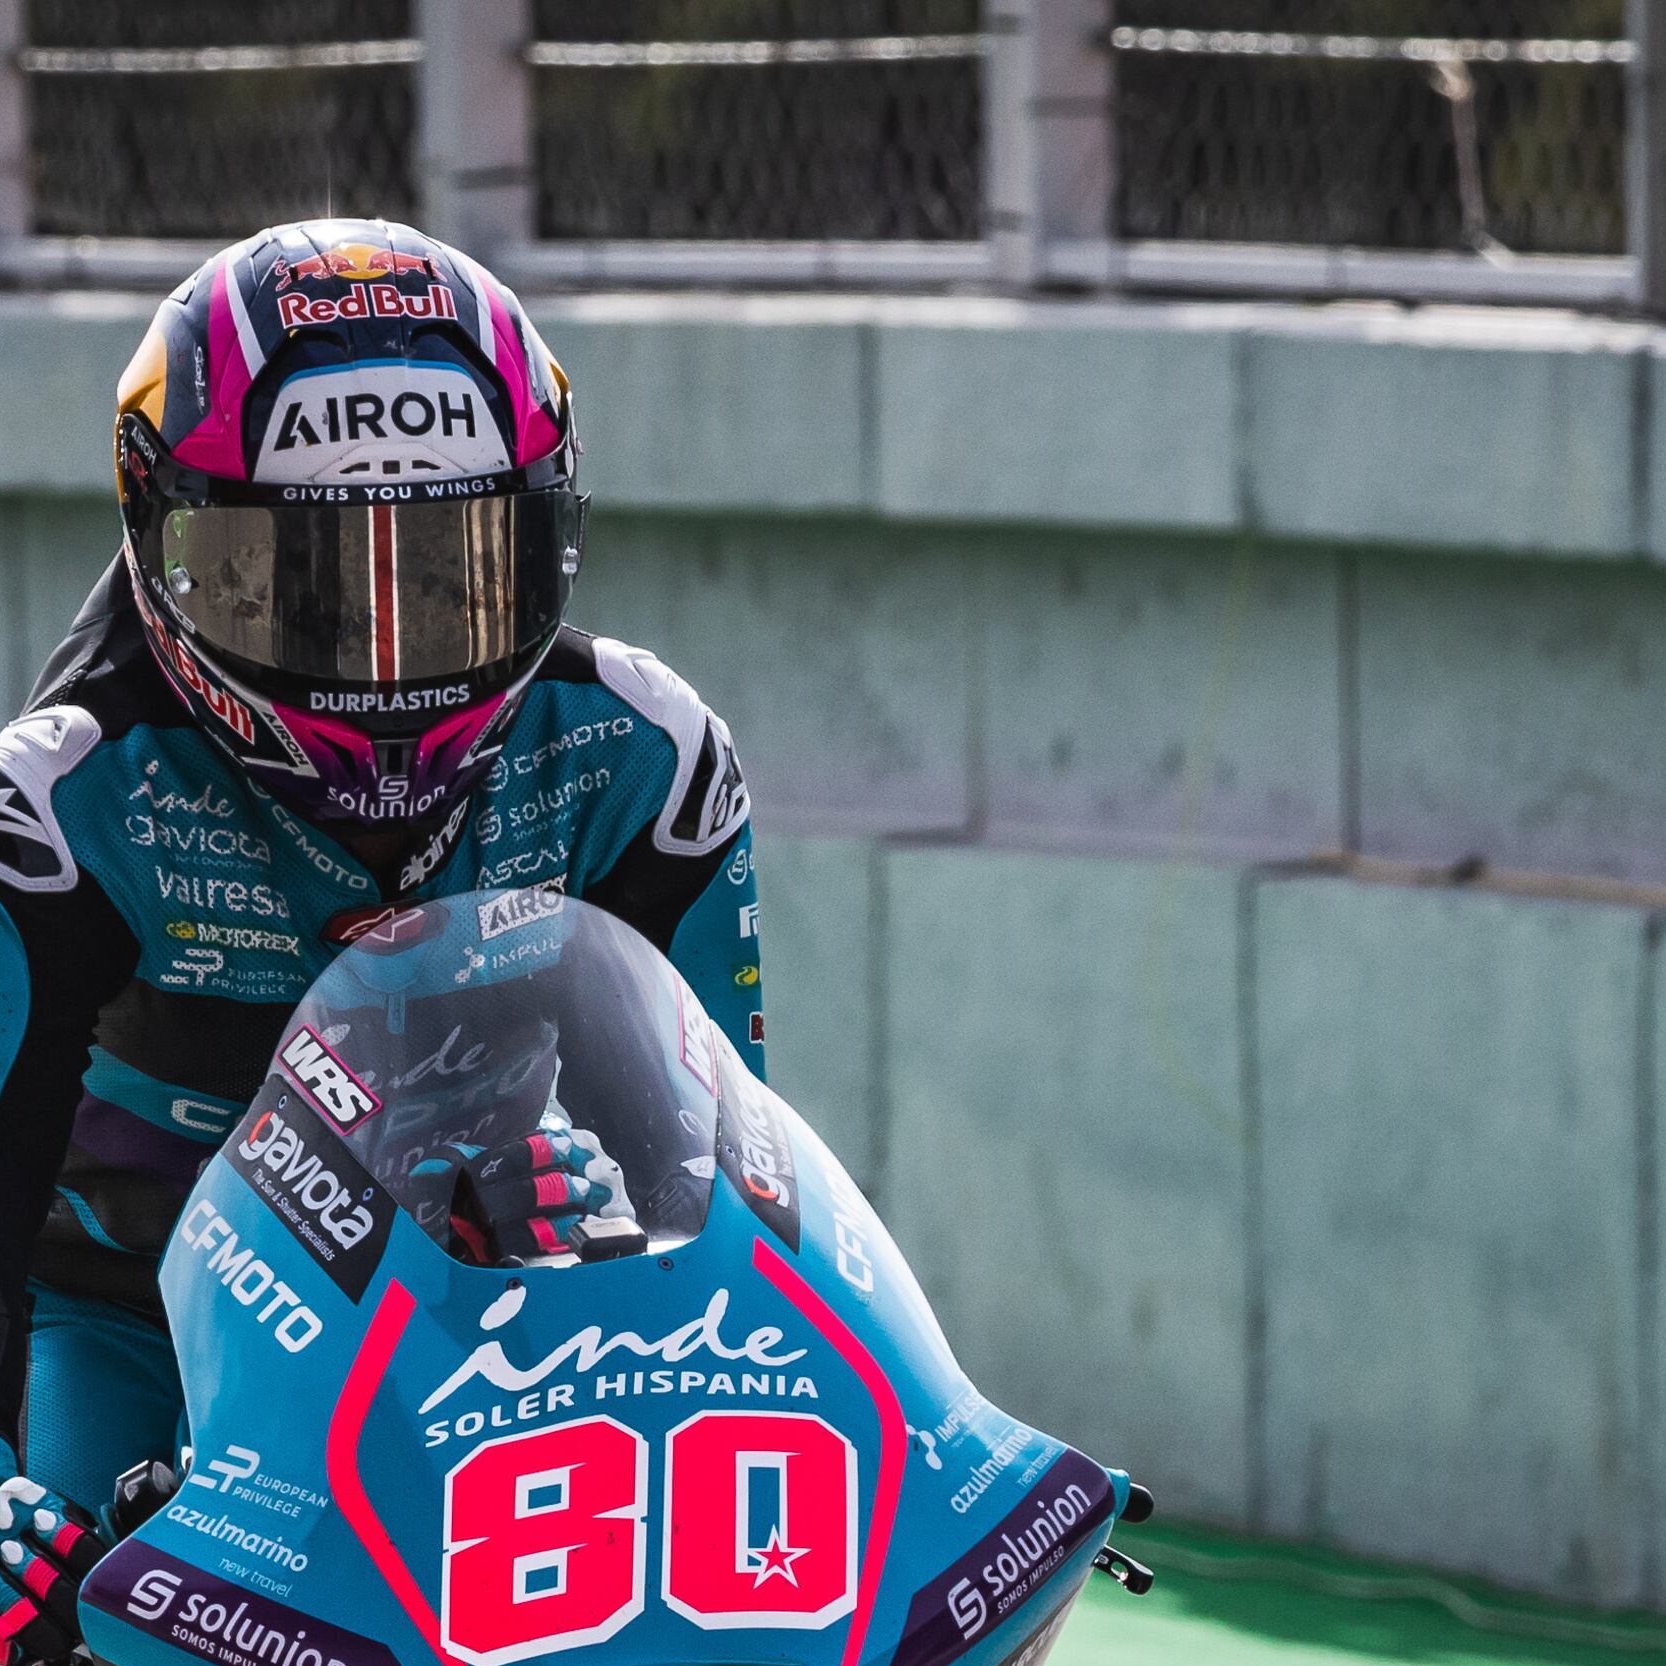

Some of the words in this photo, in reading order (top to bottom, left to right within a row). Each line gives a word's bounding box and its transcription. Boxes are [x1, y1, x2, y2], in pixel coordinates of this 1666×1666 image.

[278, 284, 367, 328] Red
[370, 284, 458, 322] Bull
[131, 426, 157, 464] AIROH
[273, 391, 477, 452] AIROH
[283, 486, 349, 502] GIVES
[363, 484, 413, 501] YOU
[426, 476, 496, 498] WINGS
[309, 683, 471, 712] DURPLASTICS
[263, 711, 310, 766] AIROH
[513, 716, 634, 776] CFMOTO
[129, 759, 234, 818] inde
[328, 784, 446, 819] solunion
[509, 767, 612, 829] solunion
[126, 814, 271, 864] gaviota
[272, 804, 368, 889] CFMOTO
[197, 922, 301, 957] MOTOREX
[282, 1030, 374, 1124] WRS
[238, 1110, 374, 1250] gaviota
[180, 1198, 324, 1354] CFMOTO
[418, 1284, 809, 1415] inde
[424, 1382, 576, 1449] SOLER
[595, 1369, 820, 1401] HISPANIA
[253, 1473, 330, 1509] EUROPEAN
[950, 1427, 1033, 1514] azulmarino
[1016, 1465, 1039, 1488] new
[232, 1485, 303, 1519] PRIVILEGE
[166, 1503, 309, 1573] azulmarino
[982, 1482, 1092, 1597] solunion
[216, 1555, 251, 1583] new
[249, 1567, 293, 1599] travel
[997, 1582, 1029, 1614] SOMOS
[1028, 1545, 1065, 1585] IMPULSO
[171, 1624, 215, 1655] SOMOS
